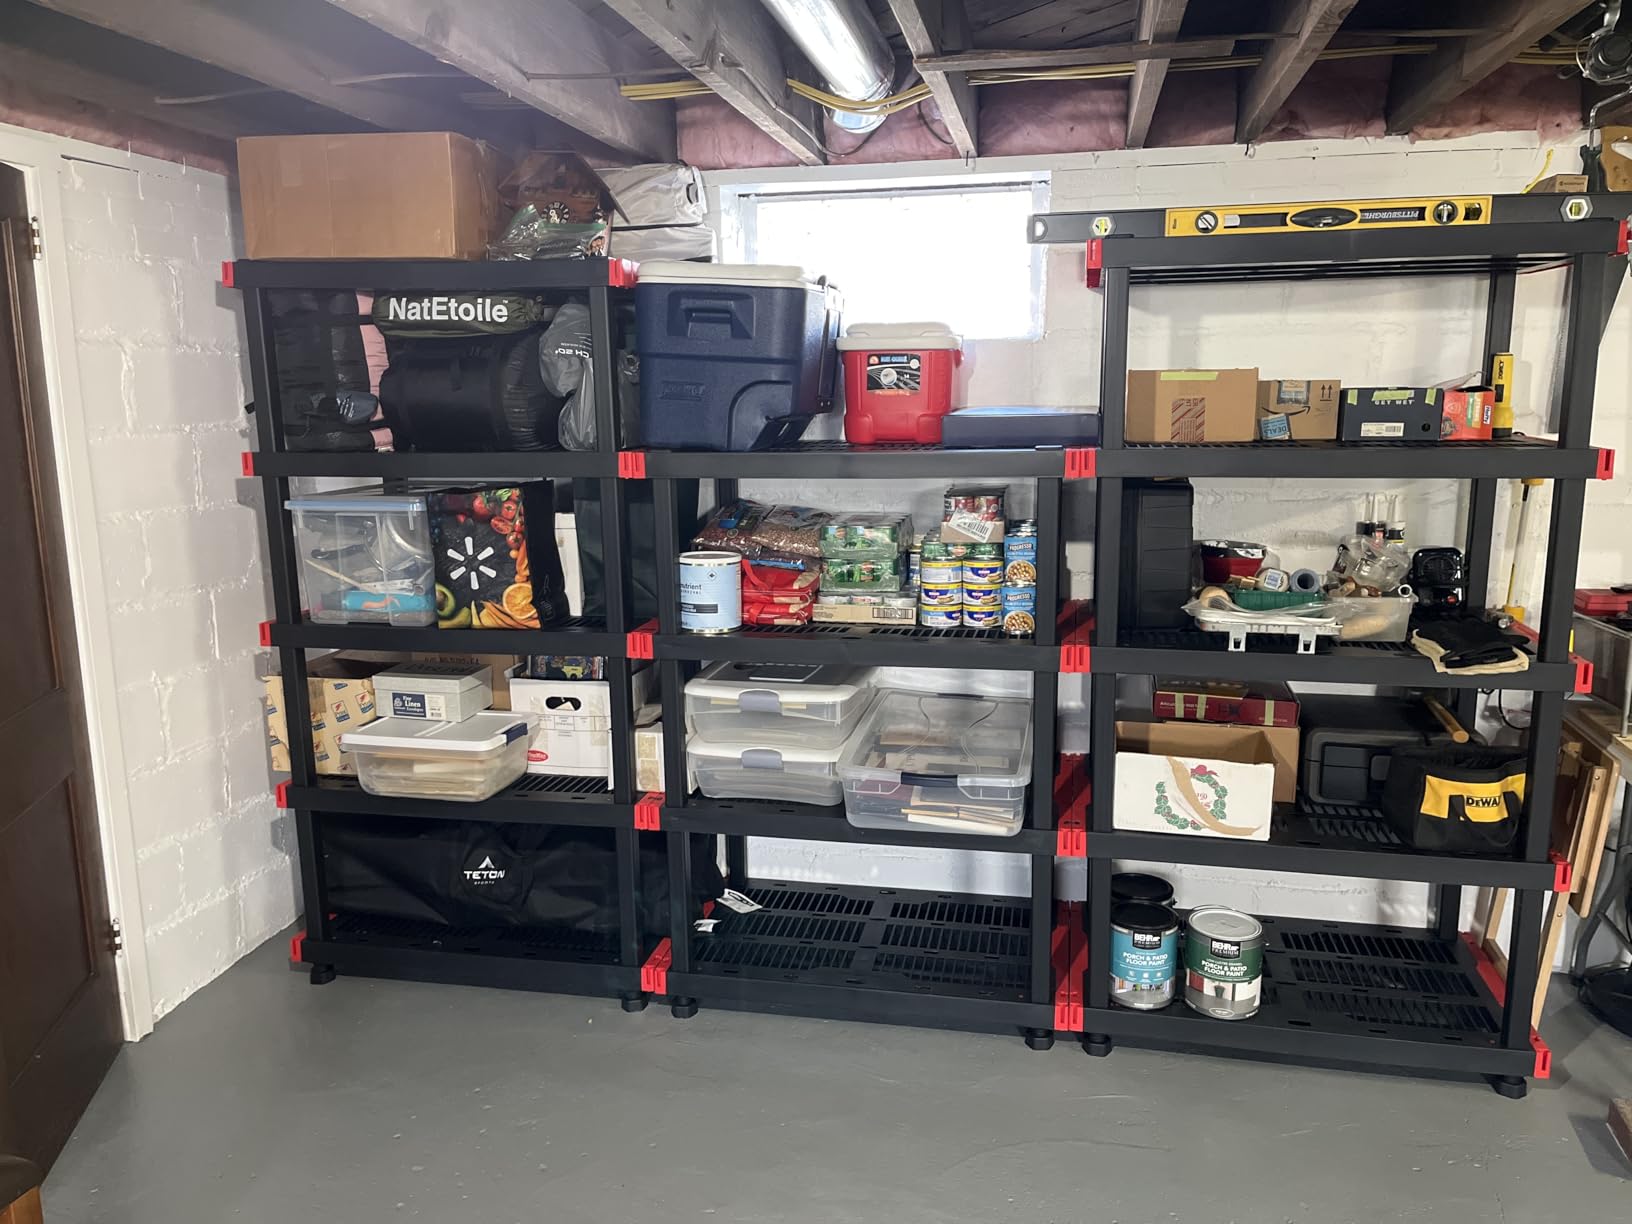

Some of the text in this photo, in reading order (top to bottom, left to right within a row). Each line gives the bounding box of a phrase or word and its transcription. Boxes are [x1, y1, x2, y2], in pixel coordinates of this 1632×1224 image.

[388, 296, 509, 323] NatEtoile
[404, 700, 421, 708] Linen
[1466, 797, 1500, 807] DEWA
[463, 870, 506, 880] TETON
[1134, 933, 1153, 941] BEHR
[1211, 941, 1232, 950] BEHR
[1123, 952, 1145, 961] PORCH
[1152, 953, 1168, 961] PATIO
[1201, 960, 1223, 970] PORCH
[1204, 966, 1225, 975] FLOOR
